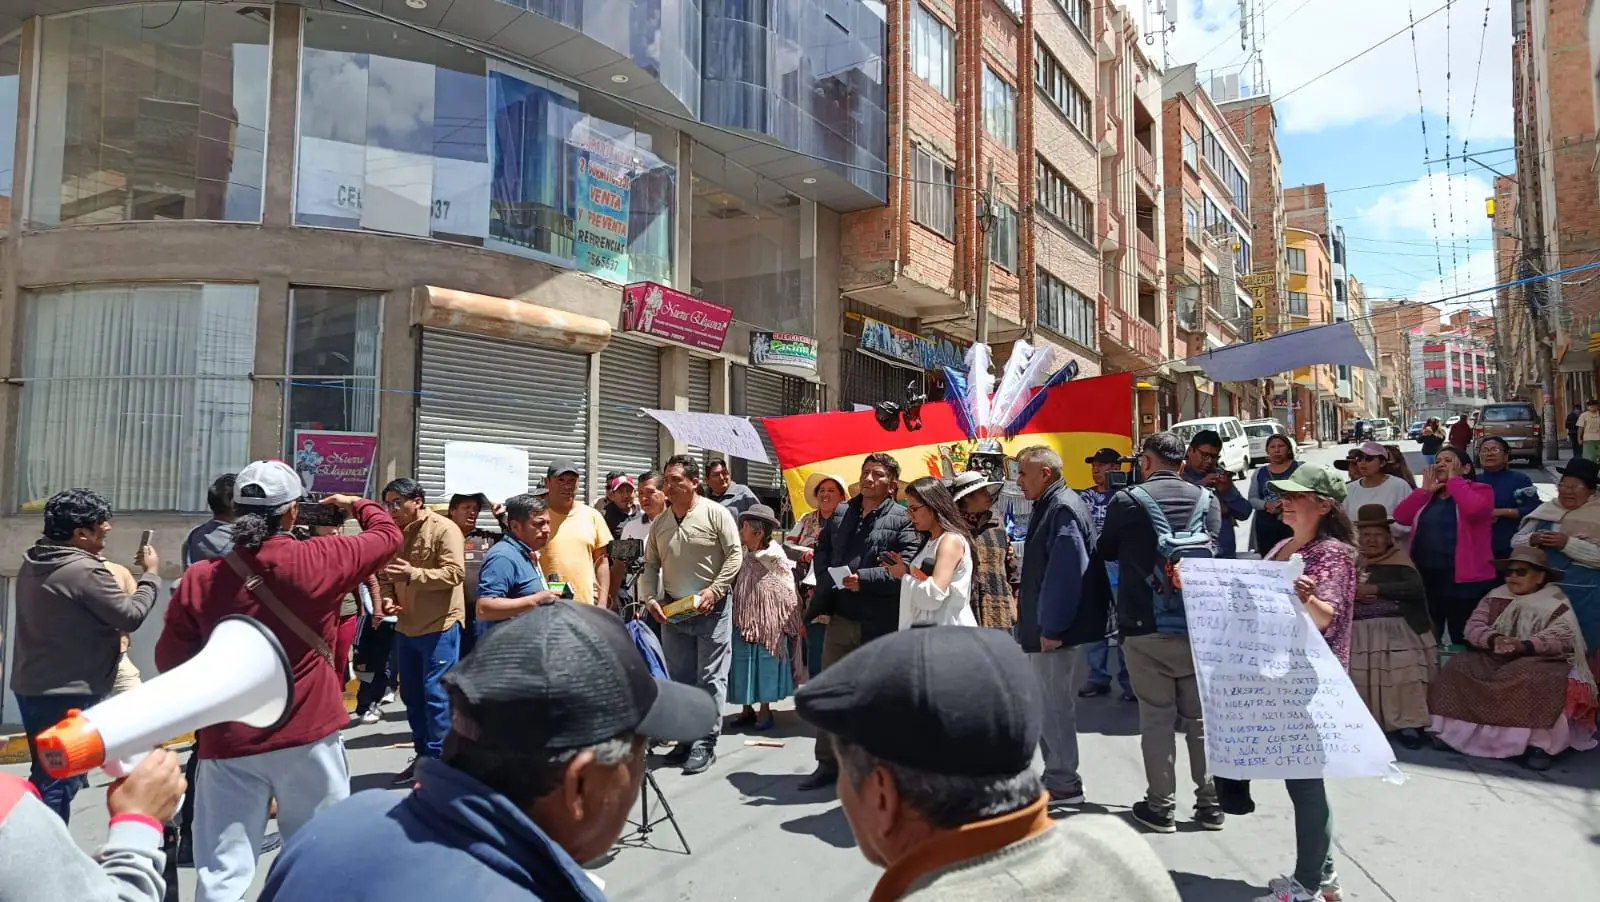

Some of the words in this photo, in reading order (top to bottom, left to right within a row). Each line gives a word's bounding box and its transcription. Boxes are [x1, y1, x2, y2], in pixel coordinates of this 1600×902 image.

[590, 186, 622, 210] VENTA
[431, 200, 450, 219] 37
[327, 452, 365, 465] Nueva
